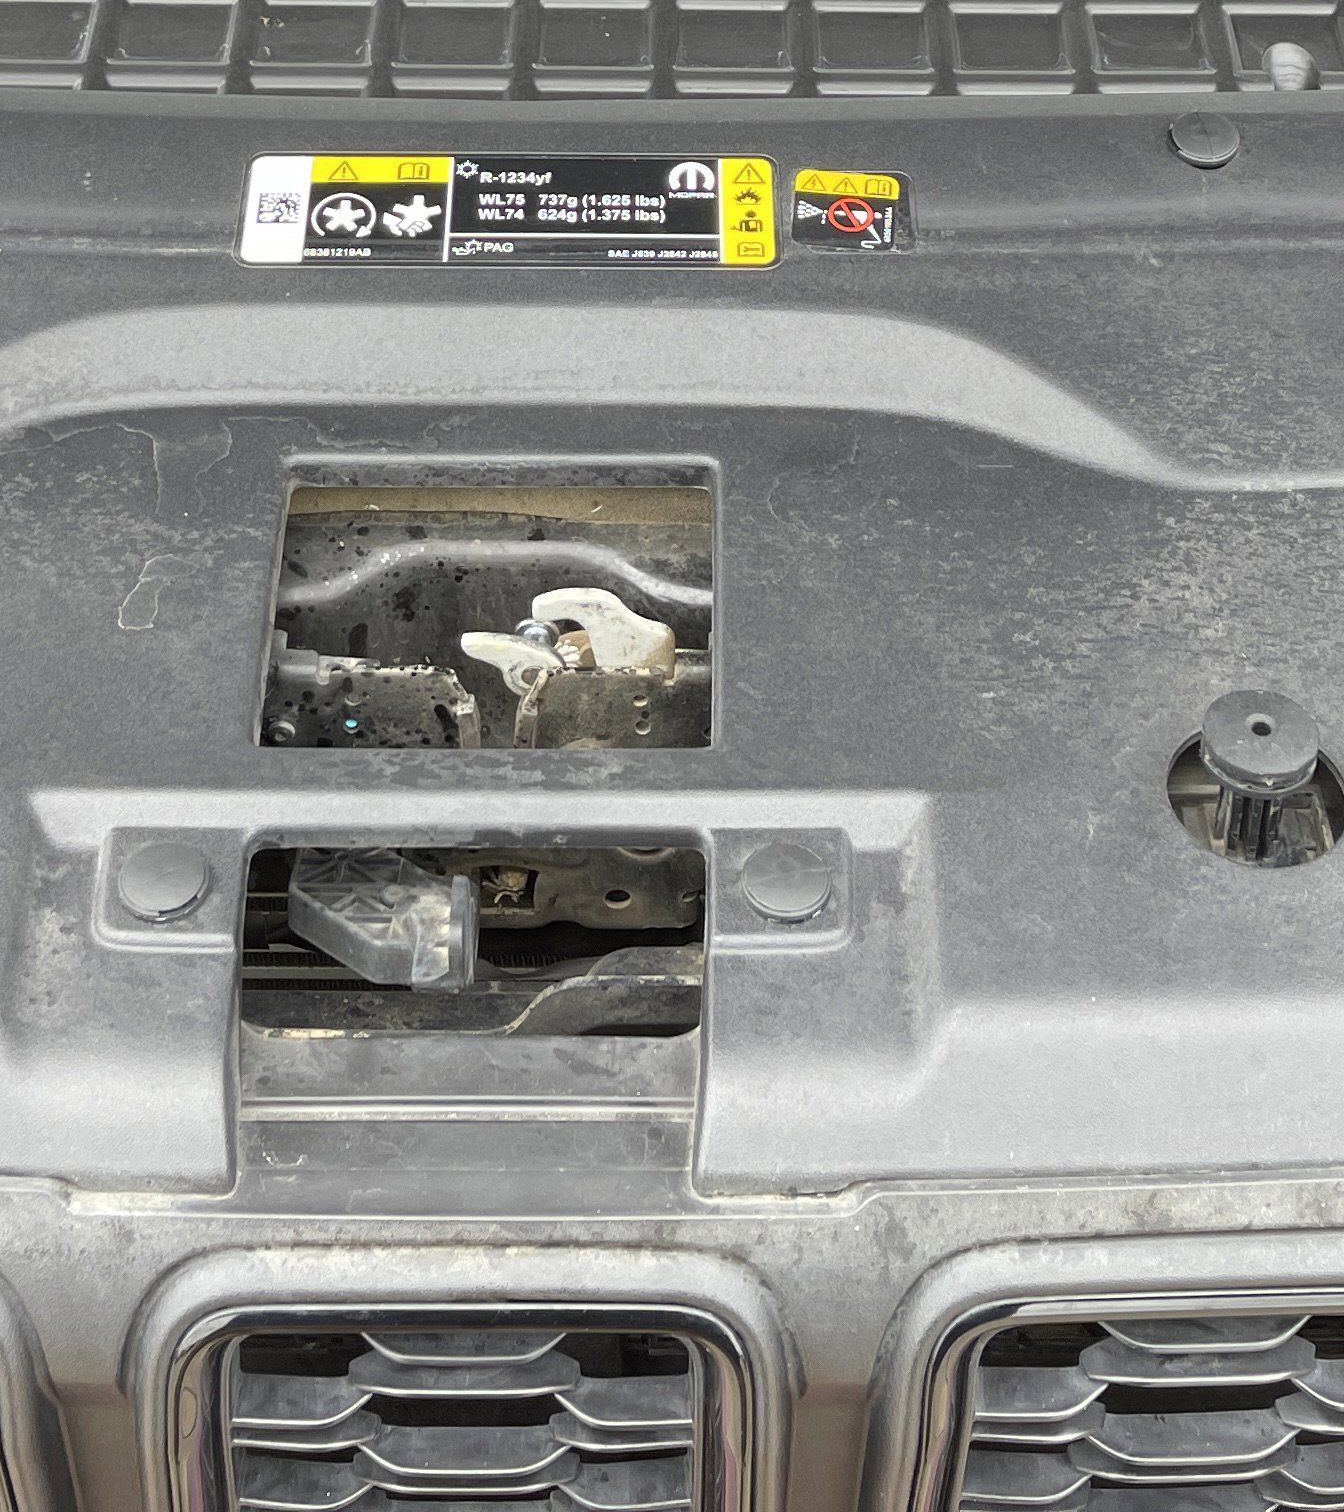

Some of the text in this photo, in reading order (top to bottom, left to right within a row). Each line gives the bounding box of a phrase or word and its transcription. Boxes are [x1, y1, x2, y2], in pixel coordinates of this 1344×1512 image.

[479, 171, 553, 186] R-1234yf
[478, 194, 666, 209] WL75 737g (1.625 lbs)
[477, 208, 666, 223] WL74 624g (1.375 lbs)
[483, 242, 514, 253] PAG
